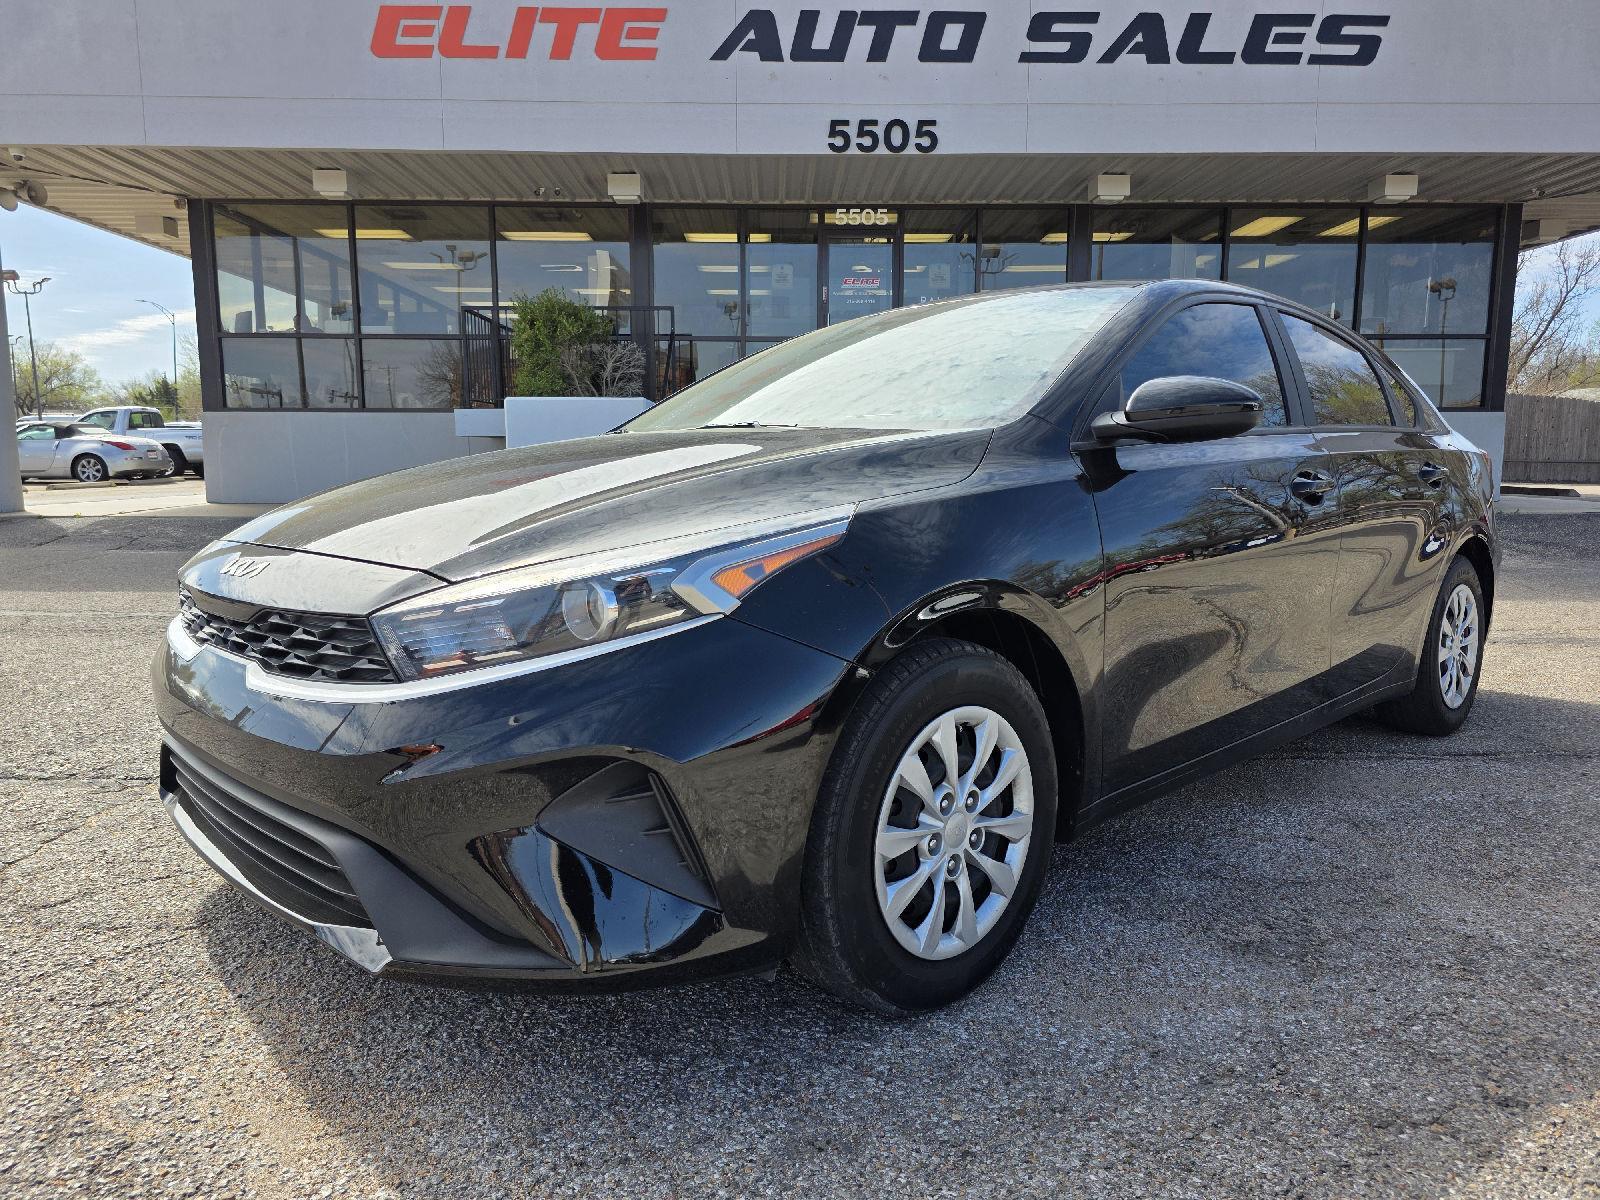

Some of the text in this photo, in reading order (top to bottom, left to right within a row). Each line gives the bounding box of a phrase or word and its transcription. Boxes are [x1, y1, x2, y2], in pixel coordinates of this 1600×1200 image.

[370, 5, 1391, 67] ELITE AUTO SALES
[827, 118, 940, 154] 5505
[834, 208, 889, 226] 5505
[842, 277, 881, 286] ELITE
